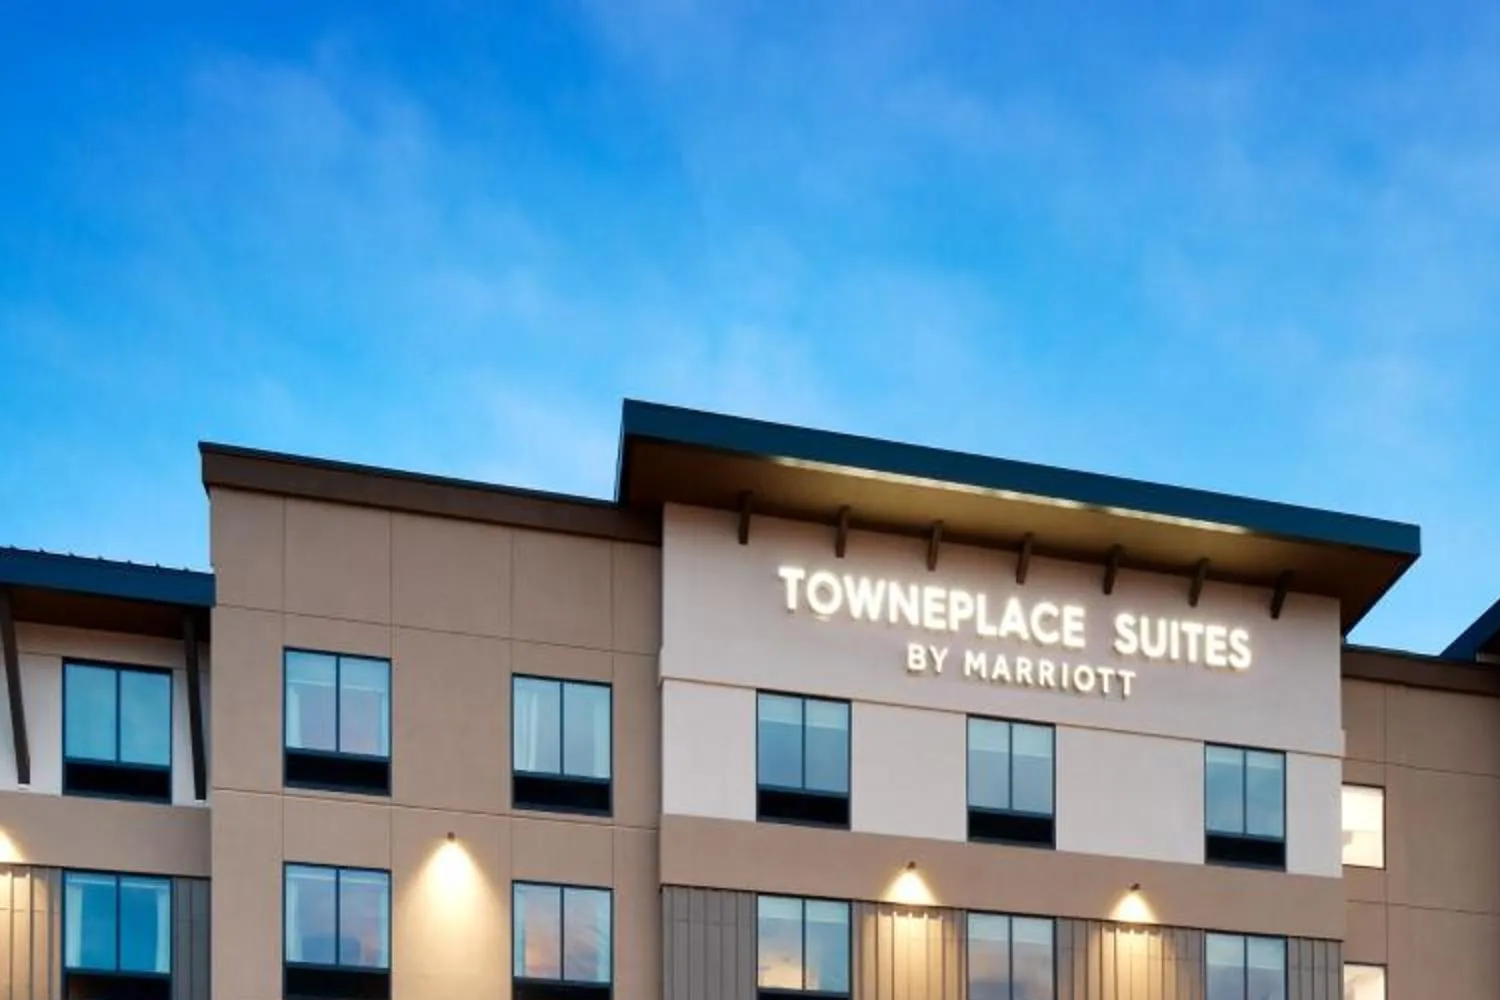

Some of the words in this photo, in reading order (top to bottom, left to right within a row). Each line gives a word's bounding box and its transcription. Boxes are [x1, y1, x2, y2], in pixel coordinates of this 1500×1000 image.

[778, 566, 1086, 648] TOWNEPLACE
[1114, 612, 1252, 669] SUITES
[907, 643, 949, 673] BY
[964, 650, 1137, 697] MARRIOTT
